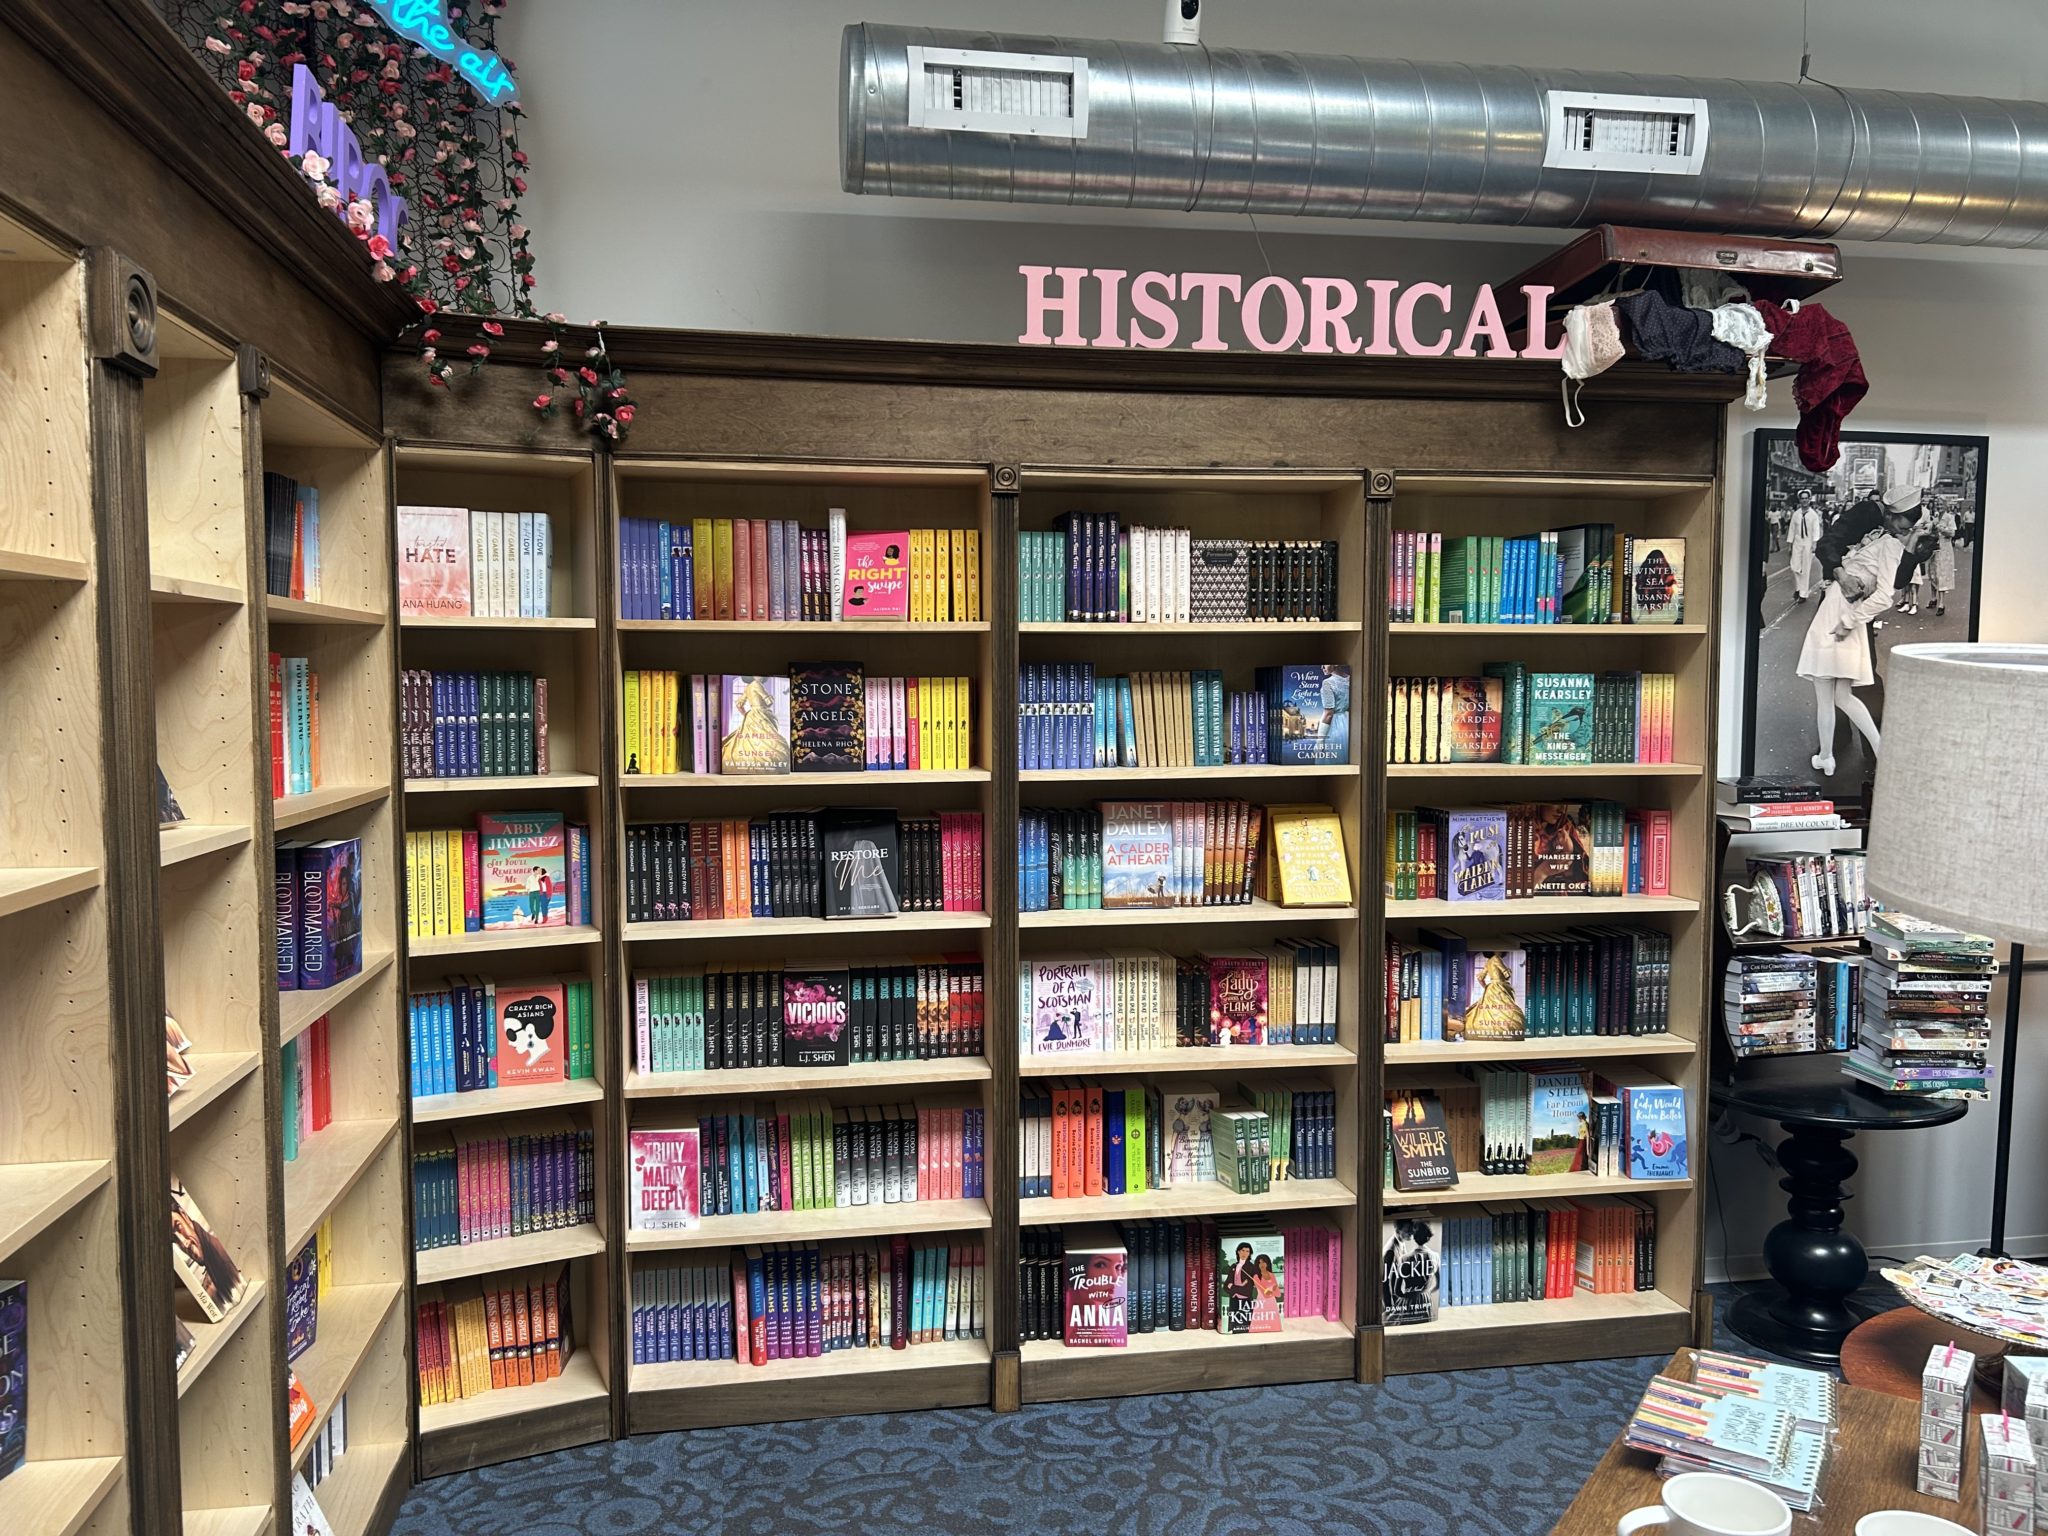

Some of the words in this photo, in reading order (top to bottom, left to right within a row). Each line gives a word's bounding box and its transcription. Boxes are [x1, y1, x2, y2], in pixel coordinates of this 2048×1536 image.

[459, 52, 515, 97] air
[1017, 265, 1569, 360] HISTORICAL
[405, 547, 457, 564] HATE
[856, 555, 874, 568] the
[848, 567, 907, 581] RIGHT
[867, 580, 904, 595] swipe
[1645, 577, 1665, 586] SEA
[402, 600, 424, 609] ANA
[426, 600, 463, 609] HUANG
[1290, 671, 1319, 681] When
[1299, 681, 1320, 689] Stars
[1536, 677, 1591, 688] SUSANNA
[800, 683, 853, 695] STONE
[1291, 689, 1312, 700] Light
[1534, 689, 1592, 700] KEARSLEY
[1301, 699, 1318, 709] Sky
[1457, 701, 1494, 712] ROSE
[800, 710, 855, 721] ANGELS
[1553, 732, 1570, 740] THE
[802, 740, 833, 748] HELENA
[835, 740, 853, 748] RHO
[1293, 742, 1342, 751] ELIZABETH
[1546, 742, 1577, 750] KING'S
[1297, 751, 1338, 759] CAMDEN
[1535, 752, 1586, 761] MESSENGER
[1109, 804, 1165, 820] JANET
[502, 823, 544, 835] ABBY
[1106, 820, 1169, 836] DAILEY
[488, 836, 560, 851] JIMENEZ
[1107, 846, 1116, 854] A
[1119, 843, 1170, 854] CALDER
[831, 848, 889, 862] RESTORE
[1107, 855, 1124, 866] AT
[1127, 854, 1170, 865] HEART
[1463, 873, 1494, 892] LANE
[1568, 882, 1586, 890] OKE
[304, 871, 323, 972] BLOODMARKED
[1038, 963, 1090, 982] PORTRAIT
[1052, 981, 1066, 994] OF
[1067, 982, 1076, 994] A
[1218, 970, 1259, 1000] Lady
[1037, 991, 1092, 1009] SCOTSMAN
[787, 1000, 846, 1025] VICIOUS
[1223, 1000, 1256, 1014] FLAME
[517, 1010, 545, 1018] ASIANS
[1056, 1037, 1092, 1050] DUNMORE
[812, 1053, 836, 1063] SHEN
[532, 1066, 556, 1074] KWAN
[1548, 1087, 1583, 1098] STEEL
[1546, 1100, 1561, 1109] Far
[1561, 1100, 1584, 1108] From
[1633, 1098, 1653, 1110] Lady
[1654, 1098, 1681, 1109] Would
[1552, 1109, 1577, 1118] Home
[1394, 1130, 1448, 1146] WILBUR
[643, 1141, 685, 1163] TRULY
[1401, 1142, 1445, 1159] SMITH
[642, 1165, 686, 1188] MADLY
[1407, 1166, 1450, 1178] SUNBIRD
[641, 1189, 689, 1211] DEEPLY
[662, 1221, 687, 1229] SHEN
[1069, 1264, 1085, 1274] THE
[1382, 1252, 1437, 1282] JACKIE
[1069, 1273, 1126, 1291] TROUBLE
[810, 1269, 818, 1312] WILLIAMS
[1190, 1280, 1198, 1312] WOMEN
[196, 1290, 208, 1305] Mia
[205, 1301, 219, 1319] West
[1238, 1299, 1265, 1311] LADY
[1385, 1304, 1408, 1313] DAWN
[1409, 1303, 1433, 1311] TRIPP
[1069, 1304, 1125, 1327] ANNA
[1229, 1311, 1277, 1324] KNIGHT
